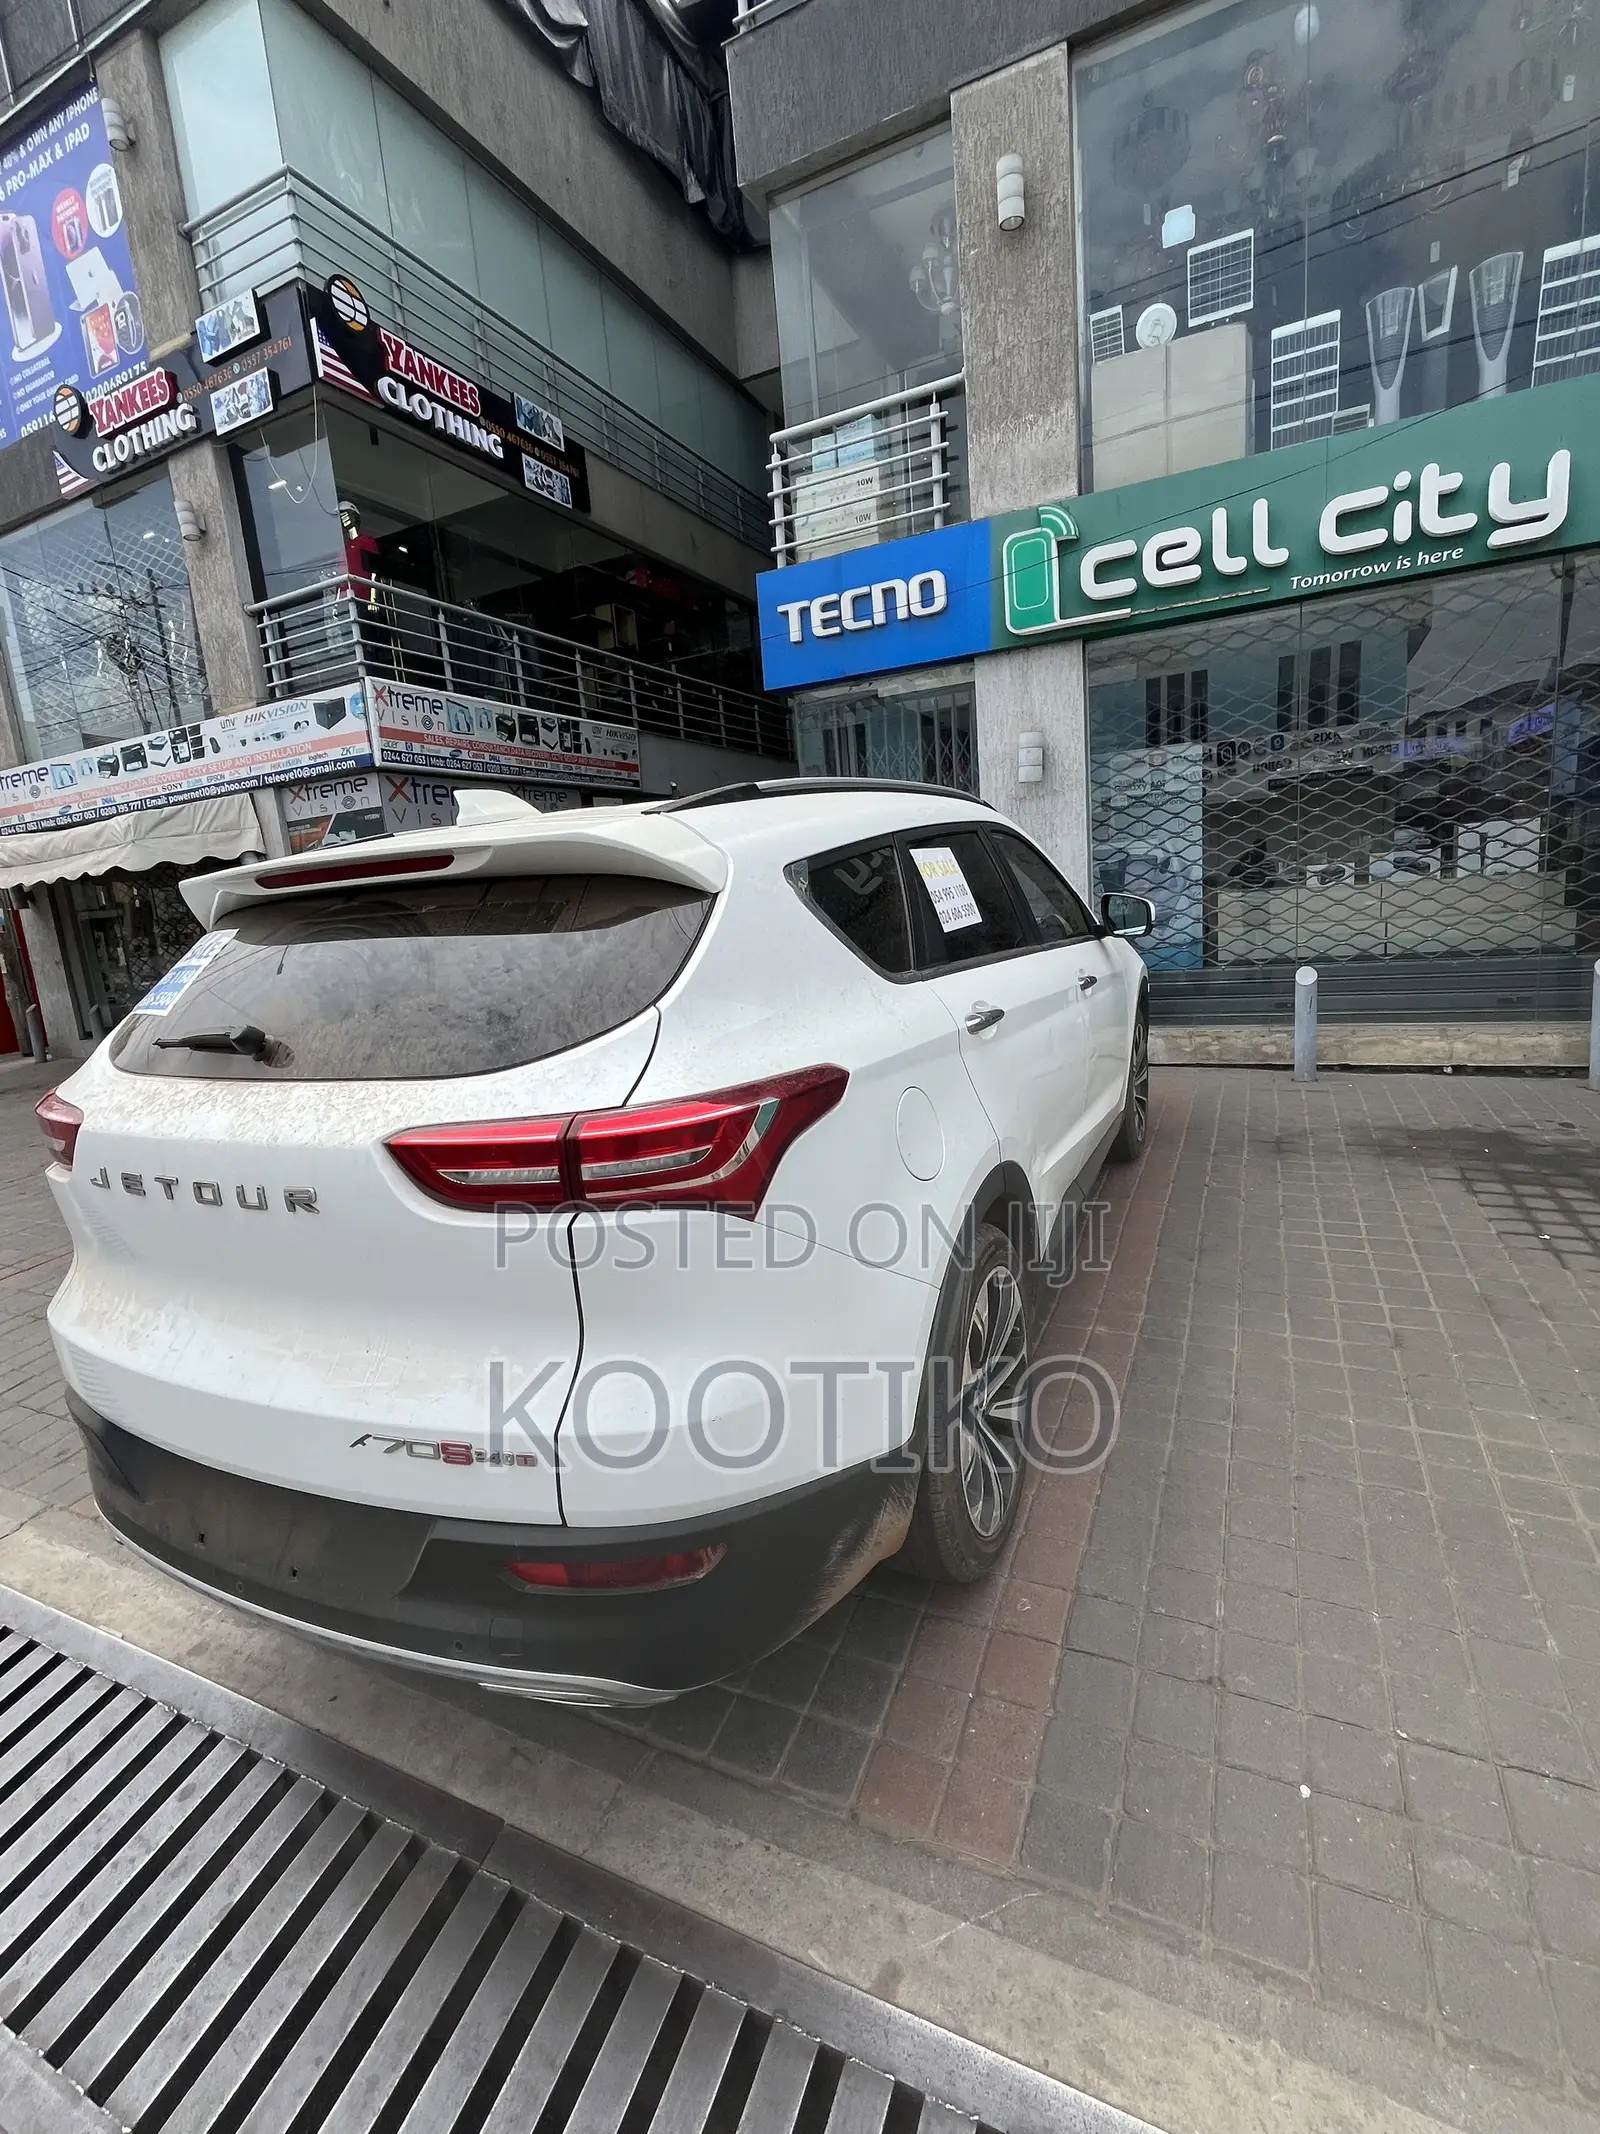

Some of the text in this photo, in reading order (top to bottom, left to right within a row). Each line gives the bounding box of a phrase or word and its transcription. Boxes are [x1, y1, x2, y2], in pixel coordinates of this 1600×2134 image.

[27, 126, 48, 151] OWN
[48, 112, 65, 136] ANY
[66, 87, 99, 122] IPHONE
[6, 148, 53, 196] PRO-MAX
[64, 122, 90, 153] IPAD
[379, 327, 481, 418] YANKEES
[89, 367, 170, 437] YANKEES
[376, 376, 504, 459] CLOTHING
[92, 402, 197, 473] CLOTHING
[856, 476, 874, 487] 10W
[855, 512, 872, 524] 10W
[1079, 448, 1572, 601] cell city
[1290, 546, 1464, 591] Tomorrow is here
[777, 569, 948, 644] TECNO
[244, 700, 309, 725] HIKVISION
[373, 683, 444, 716] Xtreme
[423, 733, 443, 747] SALES,
[208, 758, 233, 773] SETUP
[234, 755, 252, 768] AND
[254, 742, 312, 764] INSTALLATION
[383, 750, 400, 761] 0244
[401, 752, 414, 764] 627
[415, 754, 426, 765] 053
[446, 759, 461, 769] 0264
[146, 793, 169, 809] Email:
[168, 778, 259, 805] powernet10@yahoo.com
[264, 760, 356, 786] teleeye10@gmail.com
[162, 781, 184, 793] SONY
[289, 776, 369, 805] Xtreme
[917, 861, 937, 879] FOR
[936, 858, 959, 877] SALE
[930, 889, 944, 905] 054
[939, 910, 952, 925] 024
[89, 1166, 321, 1214] JETOUR
